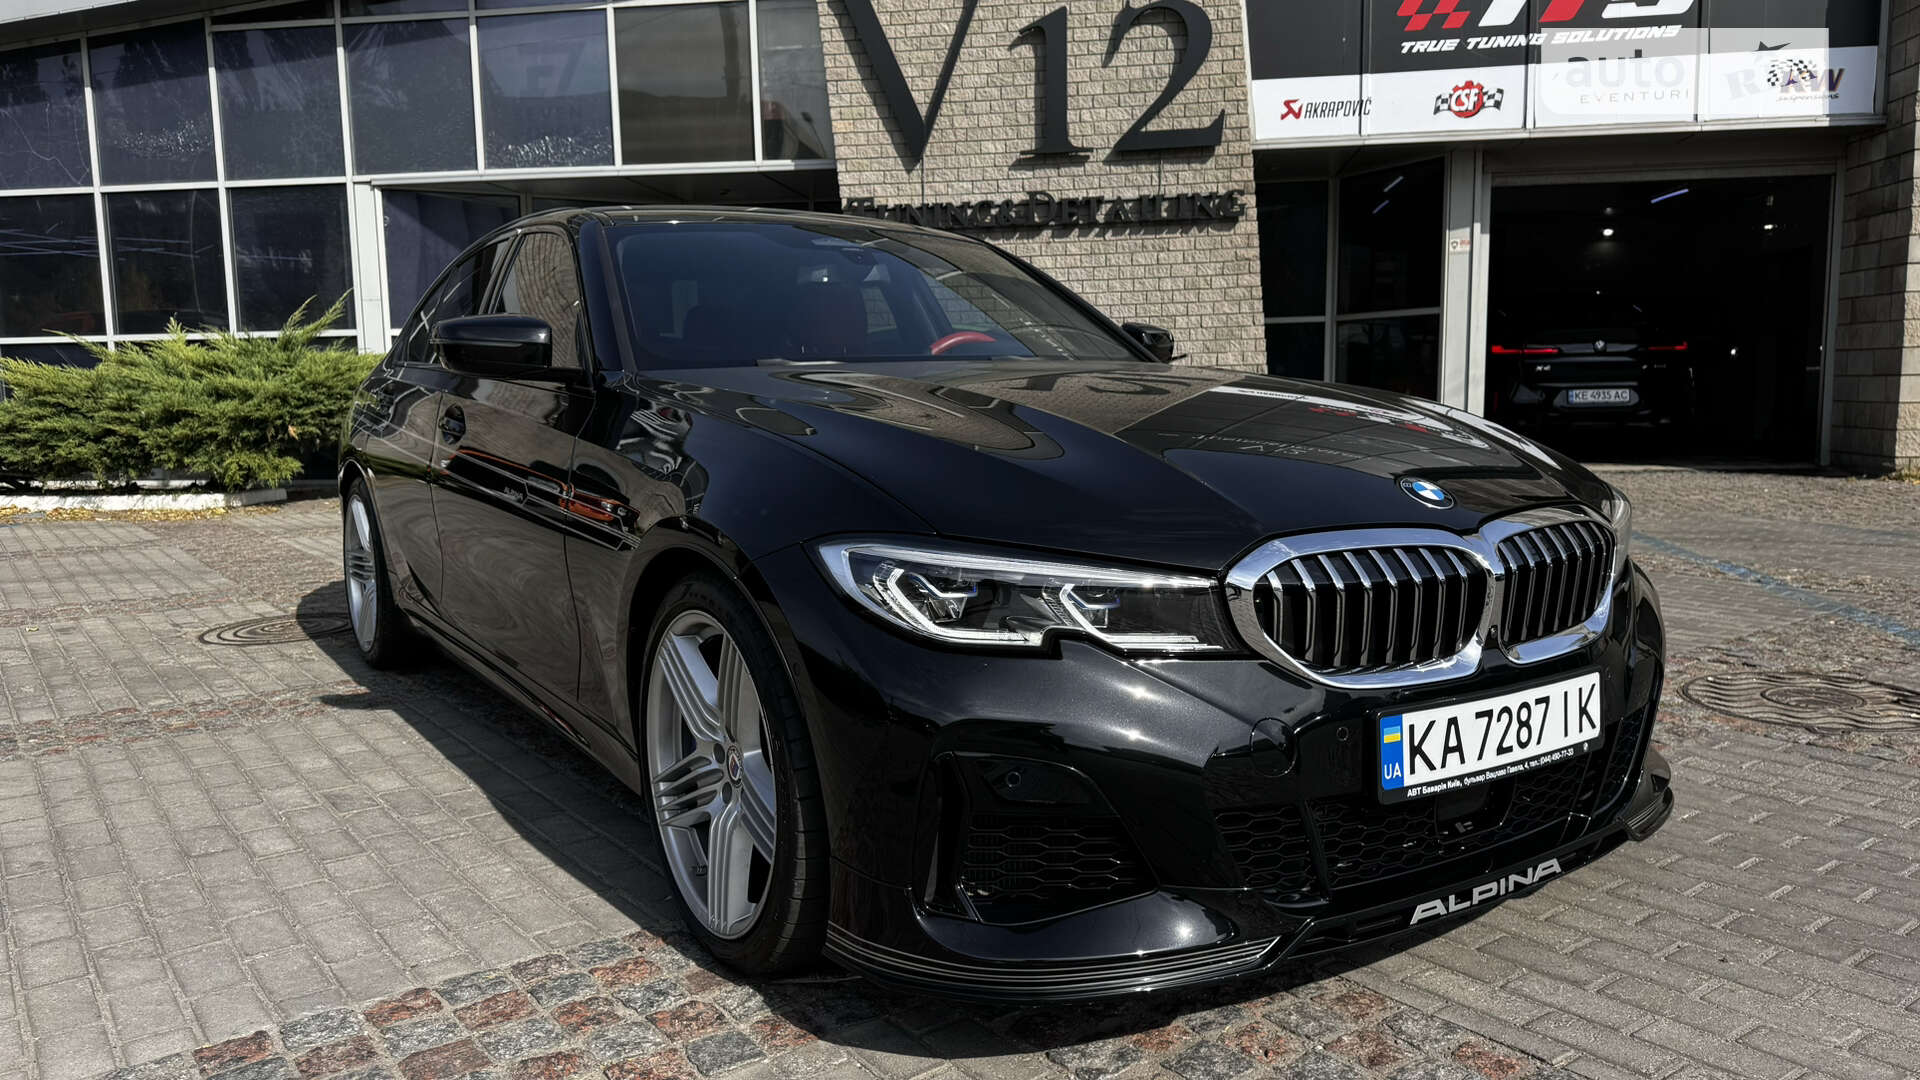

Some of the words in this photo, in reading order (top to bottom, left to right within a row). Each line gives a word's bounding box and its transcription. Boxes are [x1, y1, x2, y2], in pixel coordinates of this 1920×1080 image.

[1400, 38, 1460, 54] TRUE
[1465, 33, 1548, 50] TUNING
[1551, 25, 1683, 45] SOLUTIONS
[838, 0, 1225, 158] V12
[1450, 87, 1481, 112] CSF
[1579, 89, 1690, 105] EVENTURI
[1574, 391, 1588, 401] KE
[1614, 389, 1629, 400] AC
[1408, 715, 1466, 776] KA
[1475, 695, 1551, 761] 7287
[1562, 682, 1597, 738] IK
[1383, 762, 1402, 780] UA
[1409, 857, 1562, 926] ALPINA
